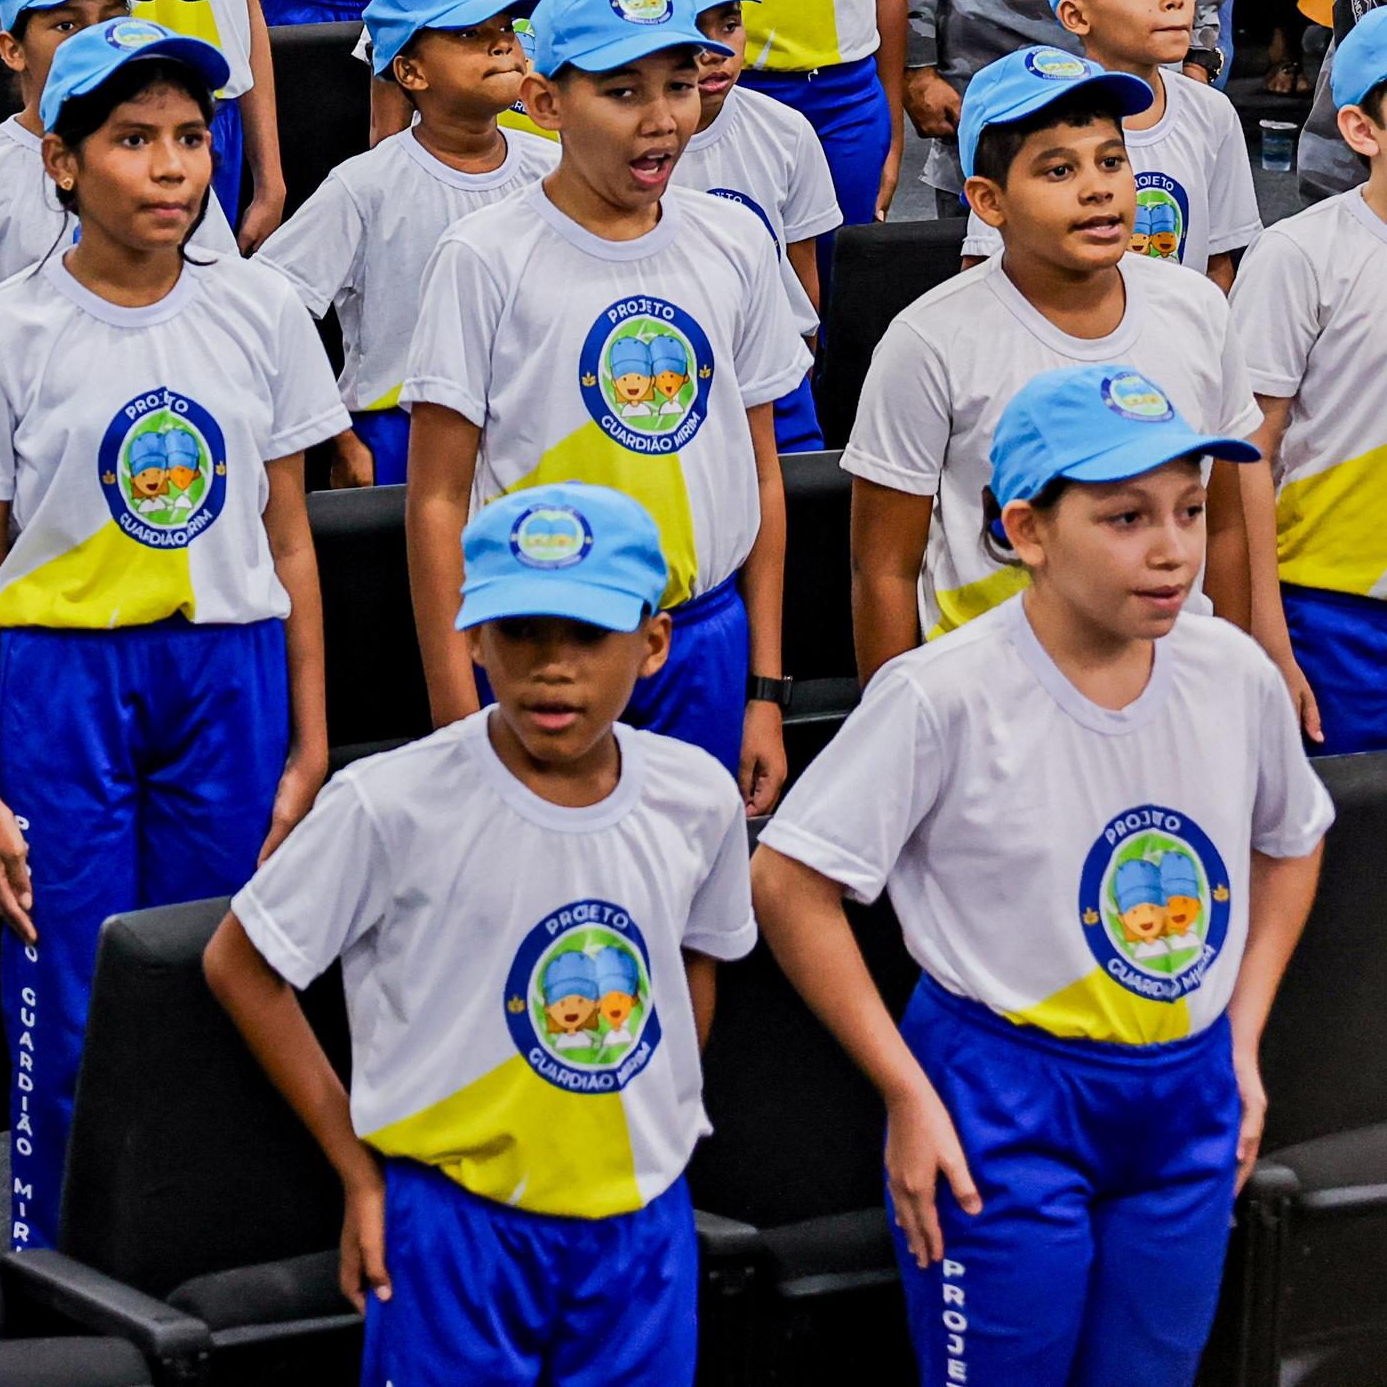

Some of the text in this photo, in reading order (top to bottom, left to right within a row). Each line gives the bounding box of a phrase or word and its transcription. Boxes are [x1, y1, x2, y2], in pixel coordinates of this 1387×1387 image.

[1133, 174, 1174, 191] ROJETO
[608, 299, 675, 323] PROJETO
[600, 410, 702, 450] GUARDIÃO MIRIM
[17, 985, 36, 1156] GUARDIÃO
[527, 1046, 615, 1090] GUARDIÃO
[12, 1177, 33, 1253] MIR
[942, 1259, 968, 1387] PROJE
